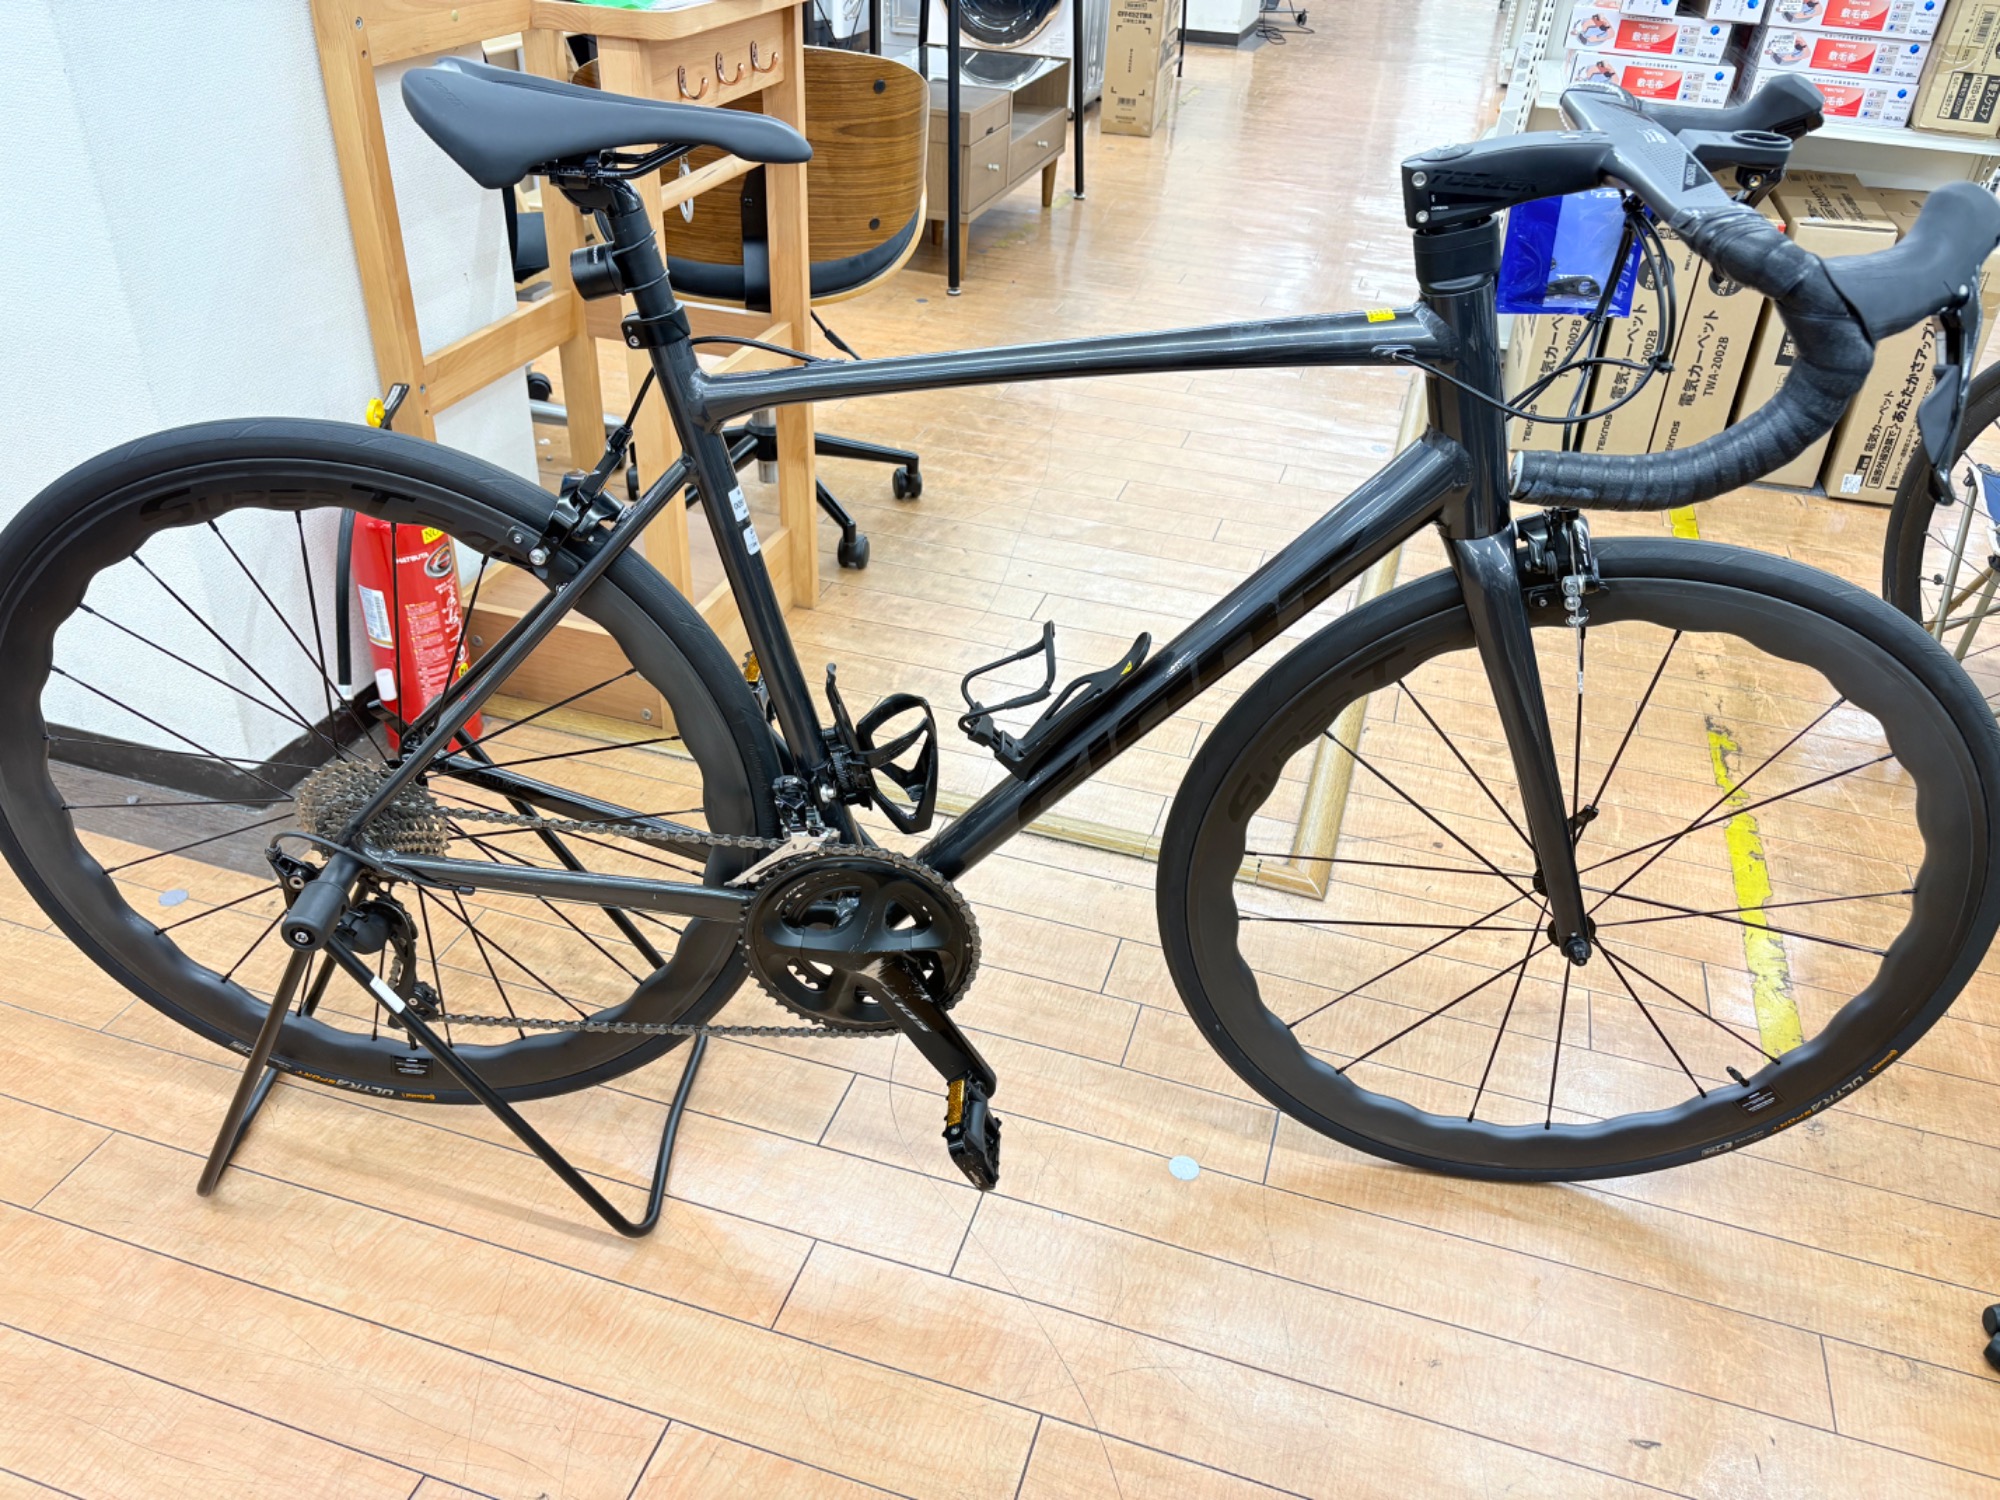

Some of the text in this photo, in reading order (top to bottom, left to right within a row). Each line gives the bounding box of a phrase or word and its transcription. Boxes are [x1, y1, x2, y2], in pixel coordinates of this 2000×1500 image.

[1678, 309, 1719, 407] 電気カーペット
[1703, 336, 1729, 397] TWA-2002B
[1665, 420, 1681, 451] EKNOS
